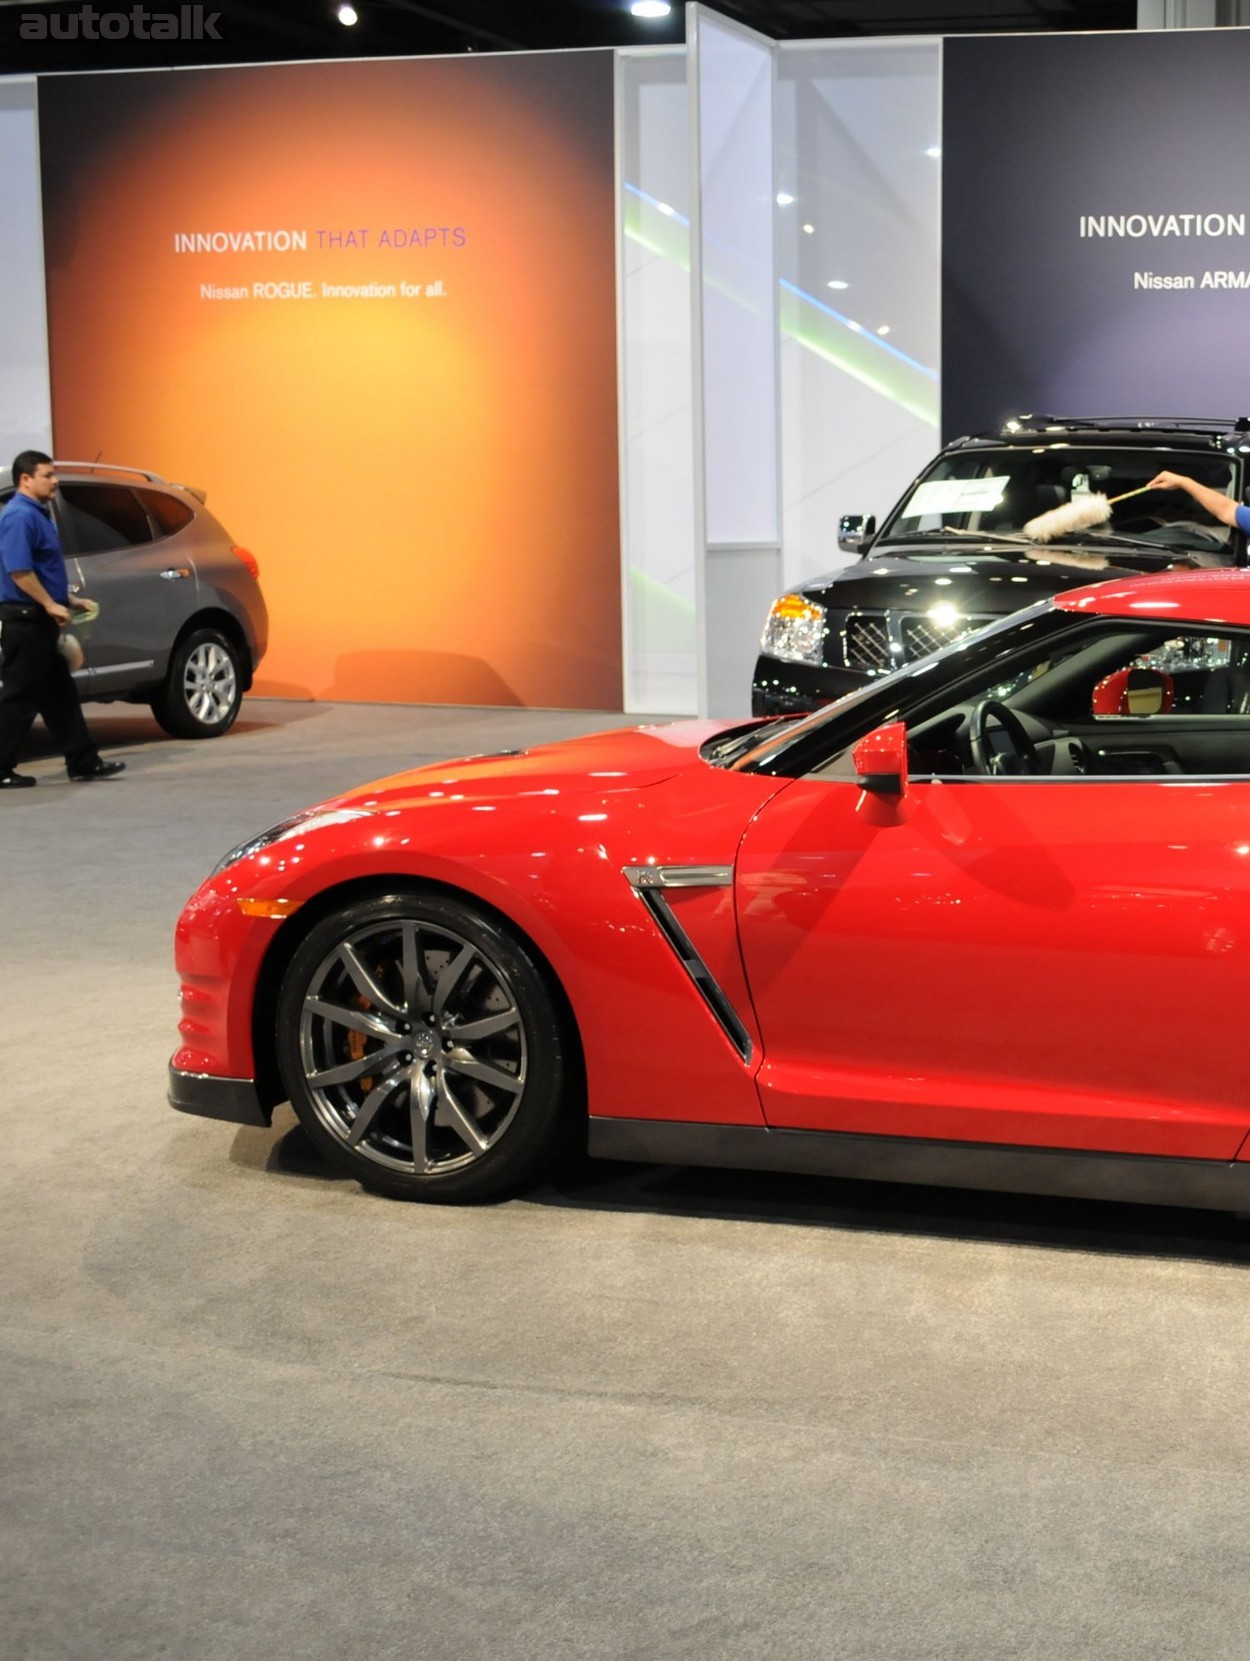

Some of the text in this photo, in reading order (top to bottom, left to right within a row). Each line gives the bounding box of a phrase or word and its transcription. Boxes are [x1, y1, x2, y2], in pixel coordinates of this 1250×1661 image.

[1080, 213, 1246, 238] INNOVATION
[174, 227, 467, 253] INNOVATION THAT ADAPTS
[200, 281, 447, 299] Nissan ROGUE. Innovation for all.
[1134, 272, 1195, 289] Nissan
